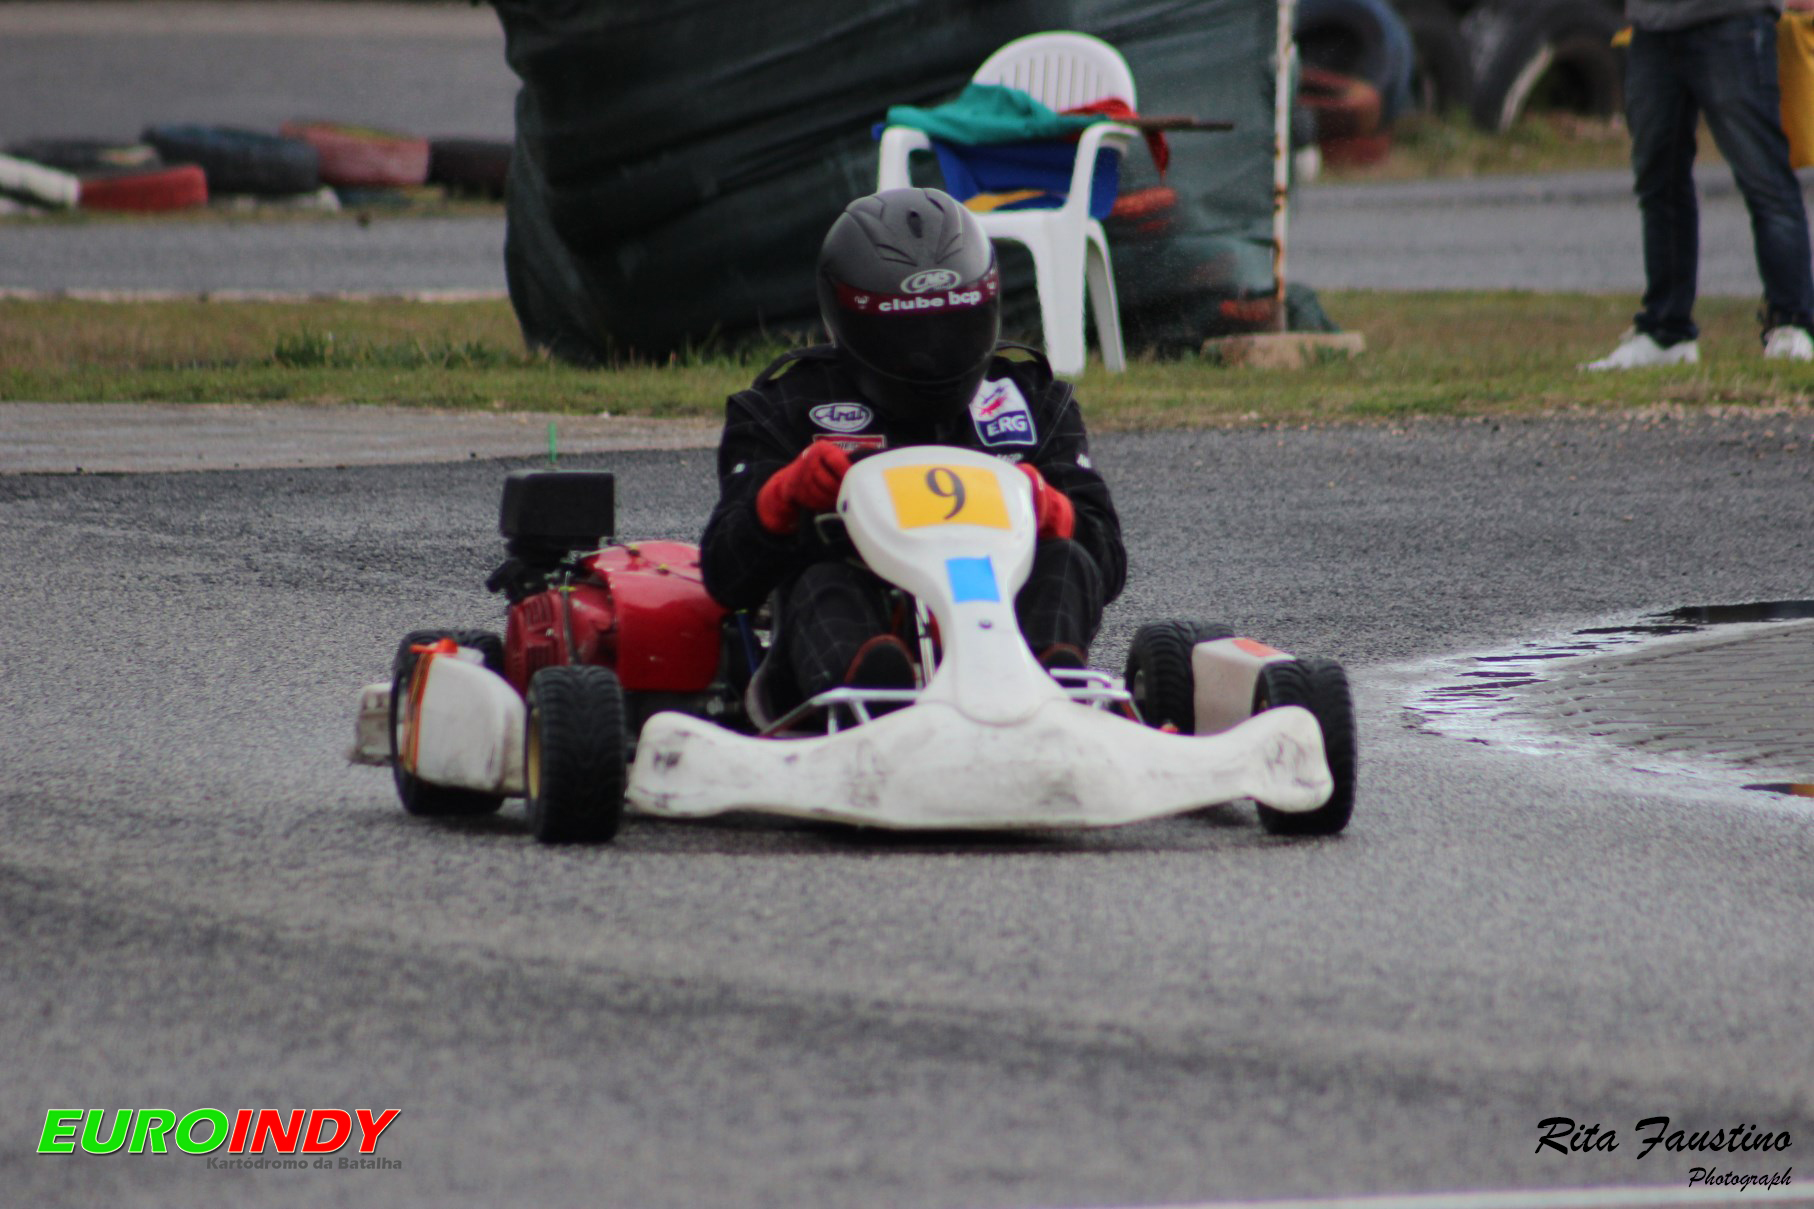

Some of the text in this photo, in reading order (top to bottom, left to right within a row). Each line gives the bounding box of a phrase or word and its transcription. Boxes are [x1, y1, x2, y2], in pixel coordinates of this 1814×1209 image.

[878, 291, 982, 312] clube bcp
[986, 414, 1028, 437] ERG
[925, 467, 967, 521] 9
